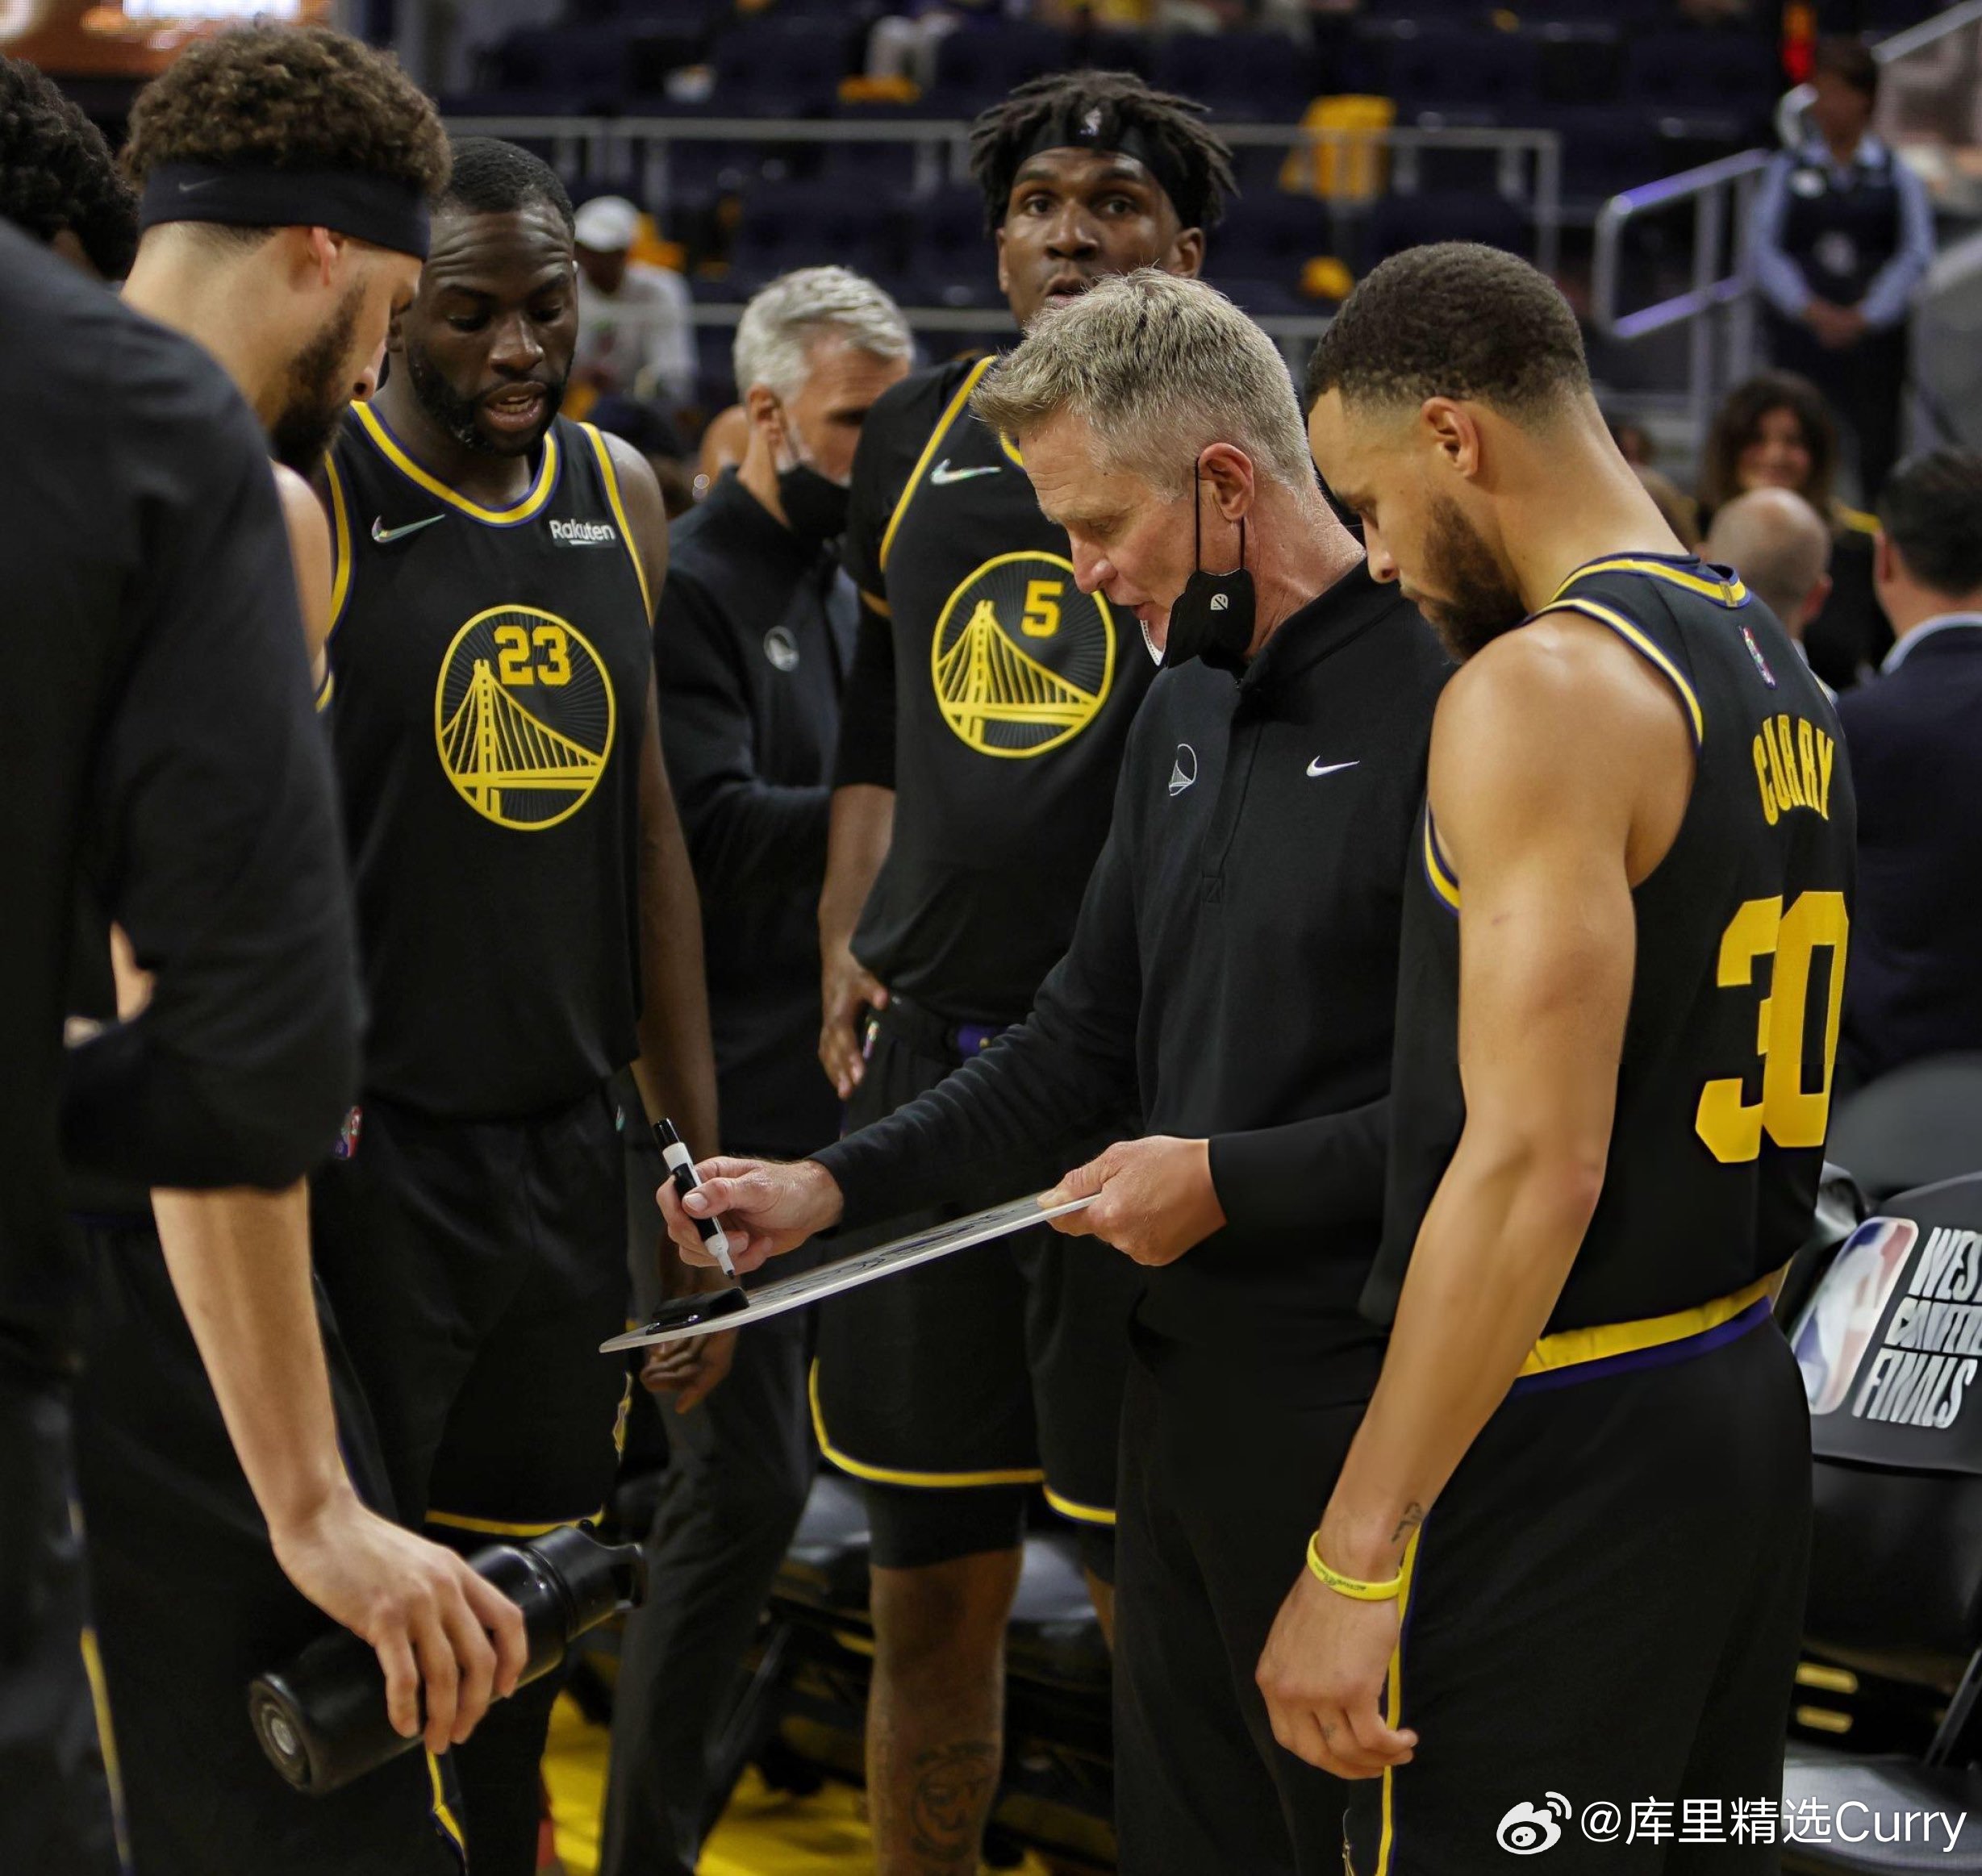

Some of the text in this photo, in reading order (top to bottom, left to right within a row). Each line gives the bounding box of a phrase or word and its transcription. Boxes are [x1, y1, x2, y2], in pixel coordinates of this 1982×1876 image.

[549, 519, 617, 540] Rakuten
[1020, 579, 1064, 638] 5
[494, 625, 571, 685] 23
[1753, 713, 1834, 826] CURRY
[1695, 891, 1849, 1164] 30
[1851, 1347, 1978, 1429] FINALS
